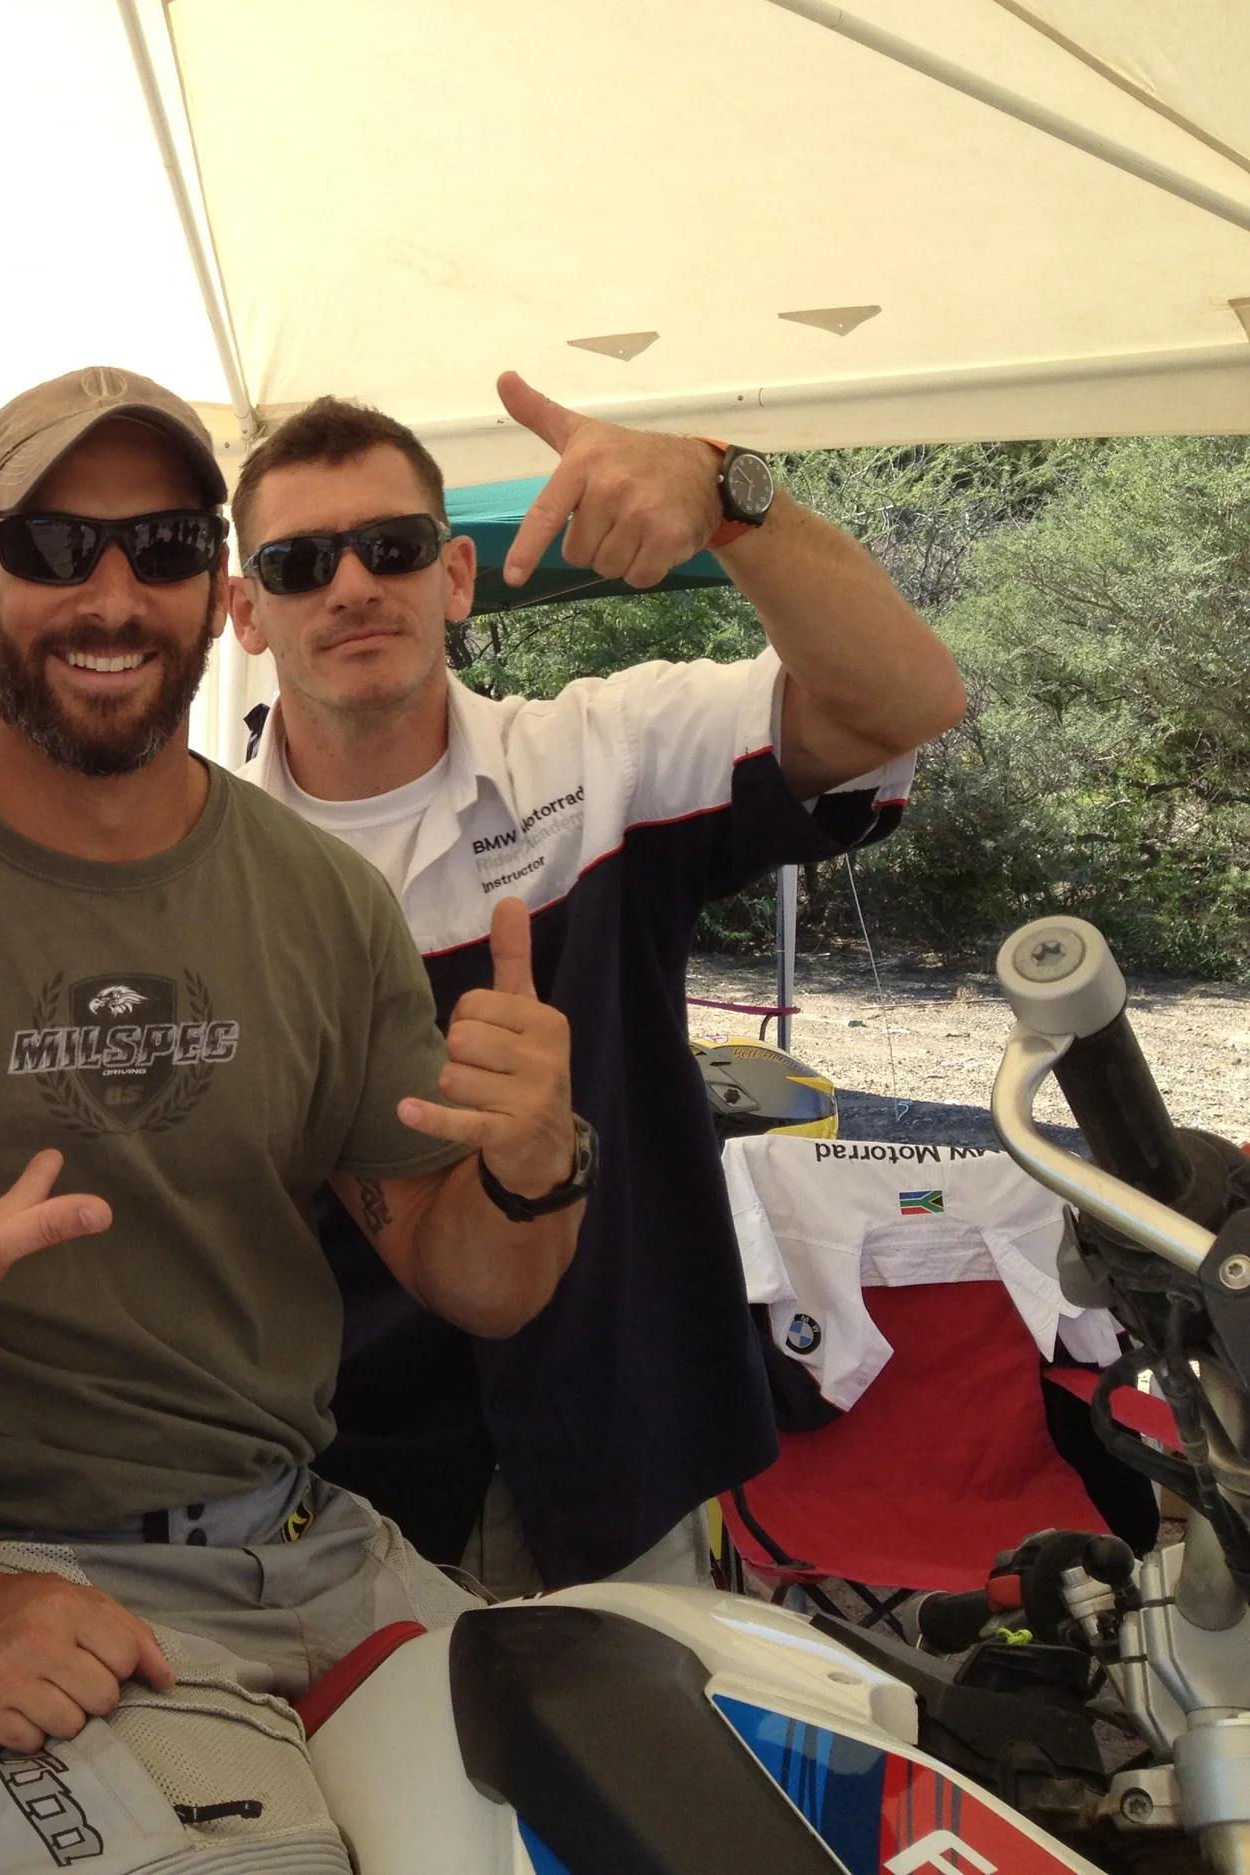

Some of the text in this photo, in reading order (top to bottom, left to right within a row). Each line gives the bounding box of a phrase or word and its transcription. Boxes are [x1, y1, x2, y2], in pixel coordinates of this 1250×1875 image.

[472, 830, 518, 854] BMW
[481, 855, 546, 894] Instructor
[7, 1020, 240, 1075] MILSPEC
[102, 1067, 147, 1077] DRIVING
[815, 1142, 942, 1165] Motorrad
